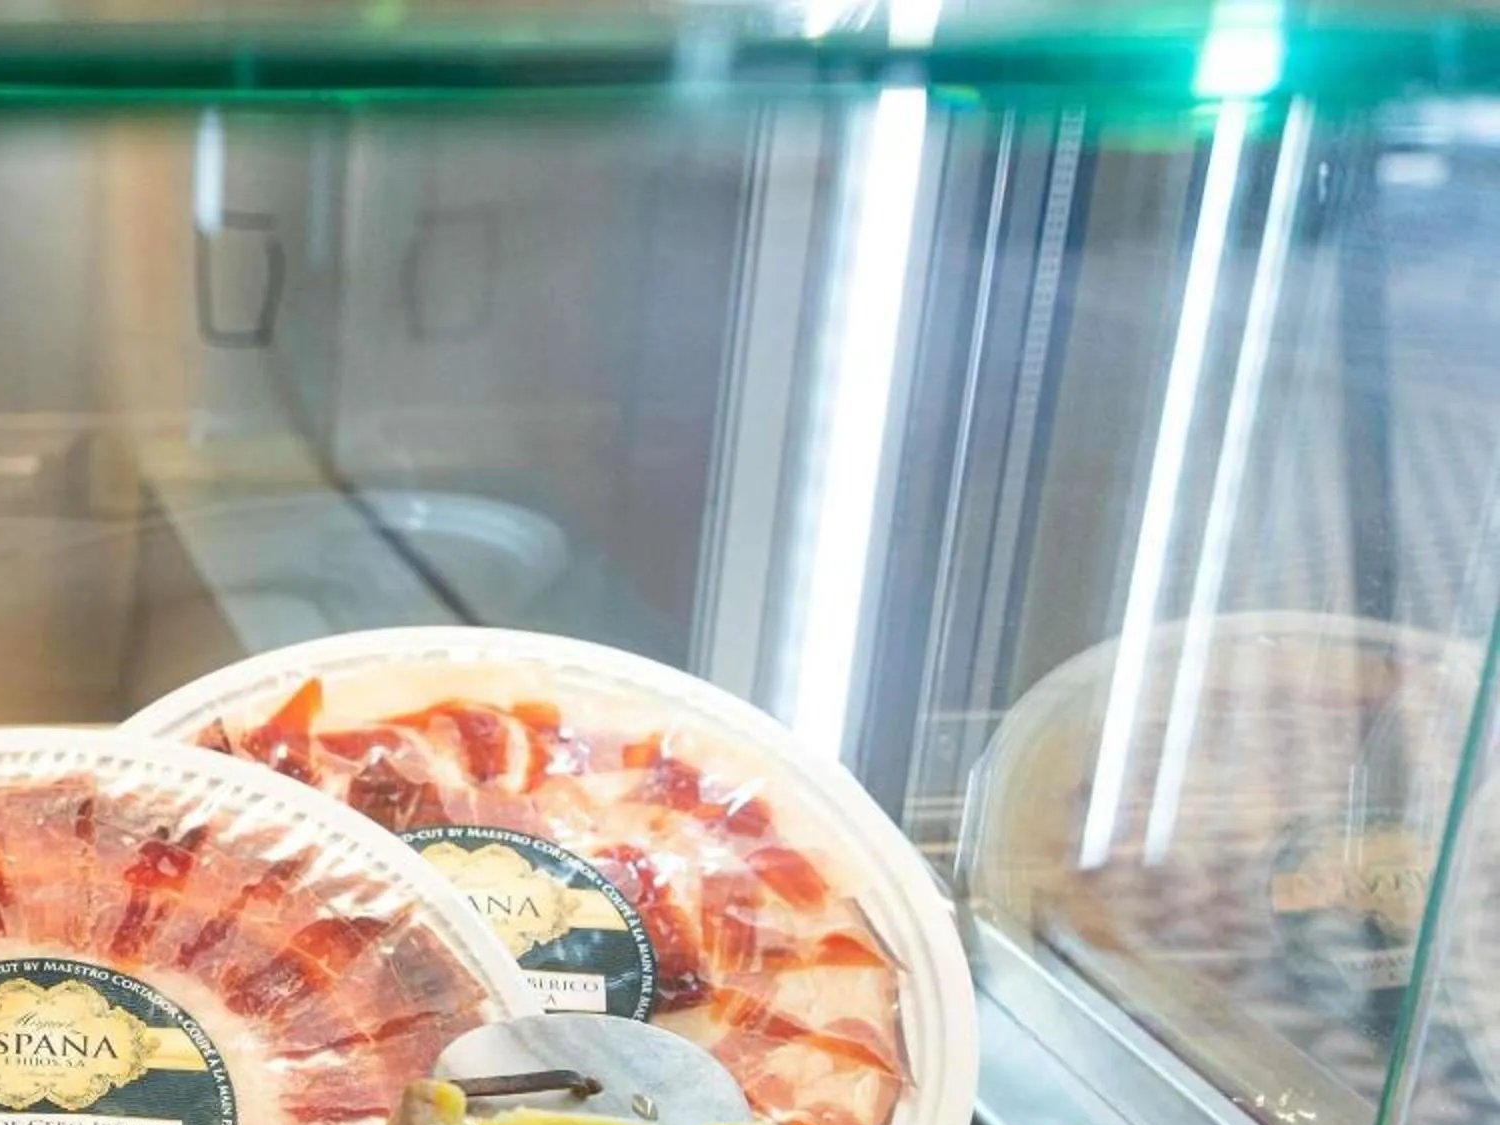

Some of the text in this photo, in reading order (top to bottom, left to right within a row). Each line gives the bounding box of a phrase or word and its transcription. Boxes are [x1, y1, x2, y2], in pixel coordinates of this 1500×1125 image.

[448, 828, 463, 837] BY
[467, 828, 531, 845] MAESTRO
[24, 962, 40, 973] BY
[43, 961, 109, 982] MAESTRO
[111, 975, 179, 1020] CORTADOR
[212, 1069, 225, 1083] LA
[217, 1085, 233, 1116] MAIN
